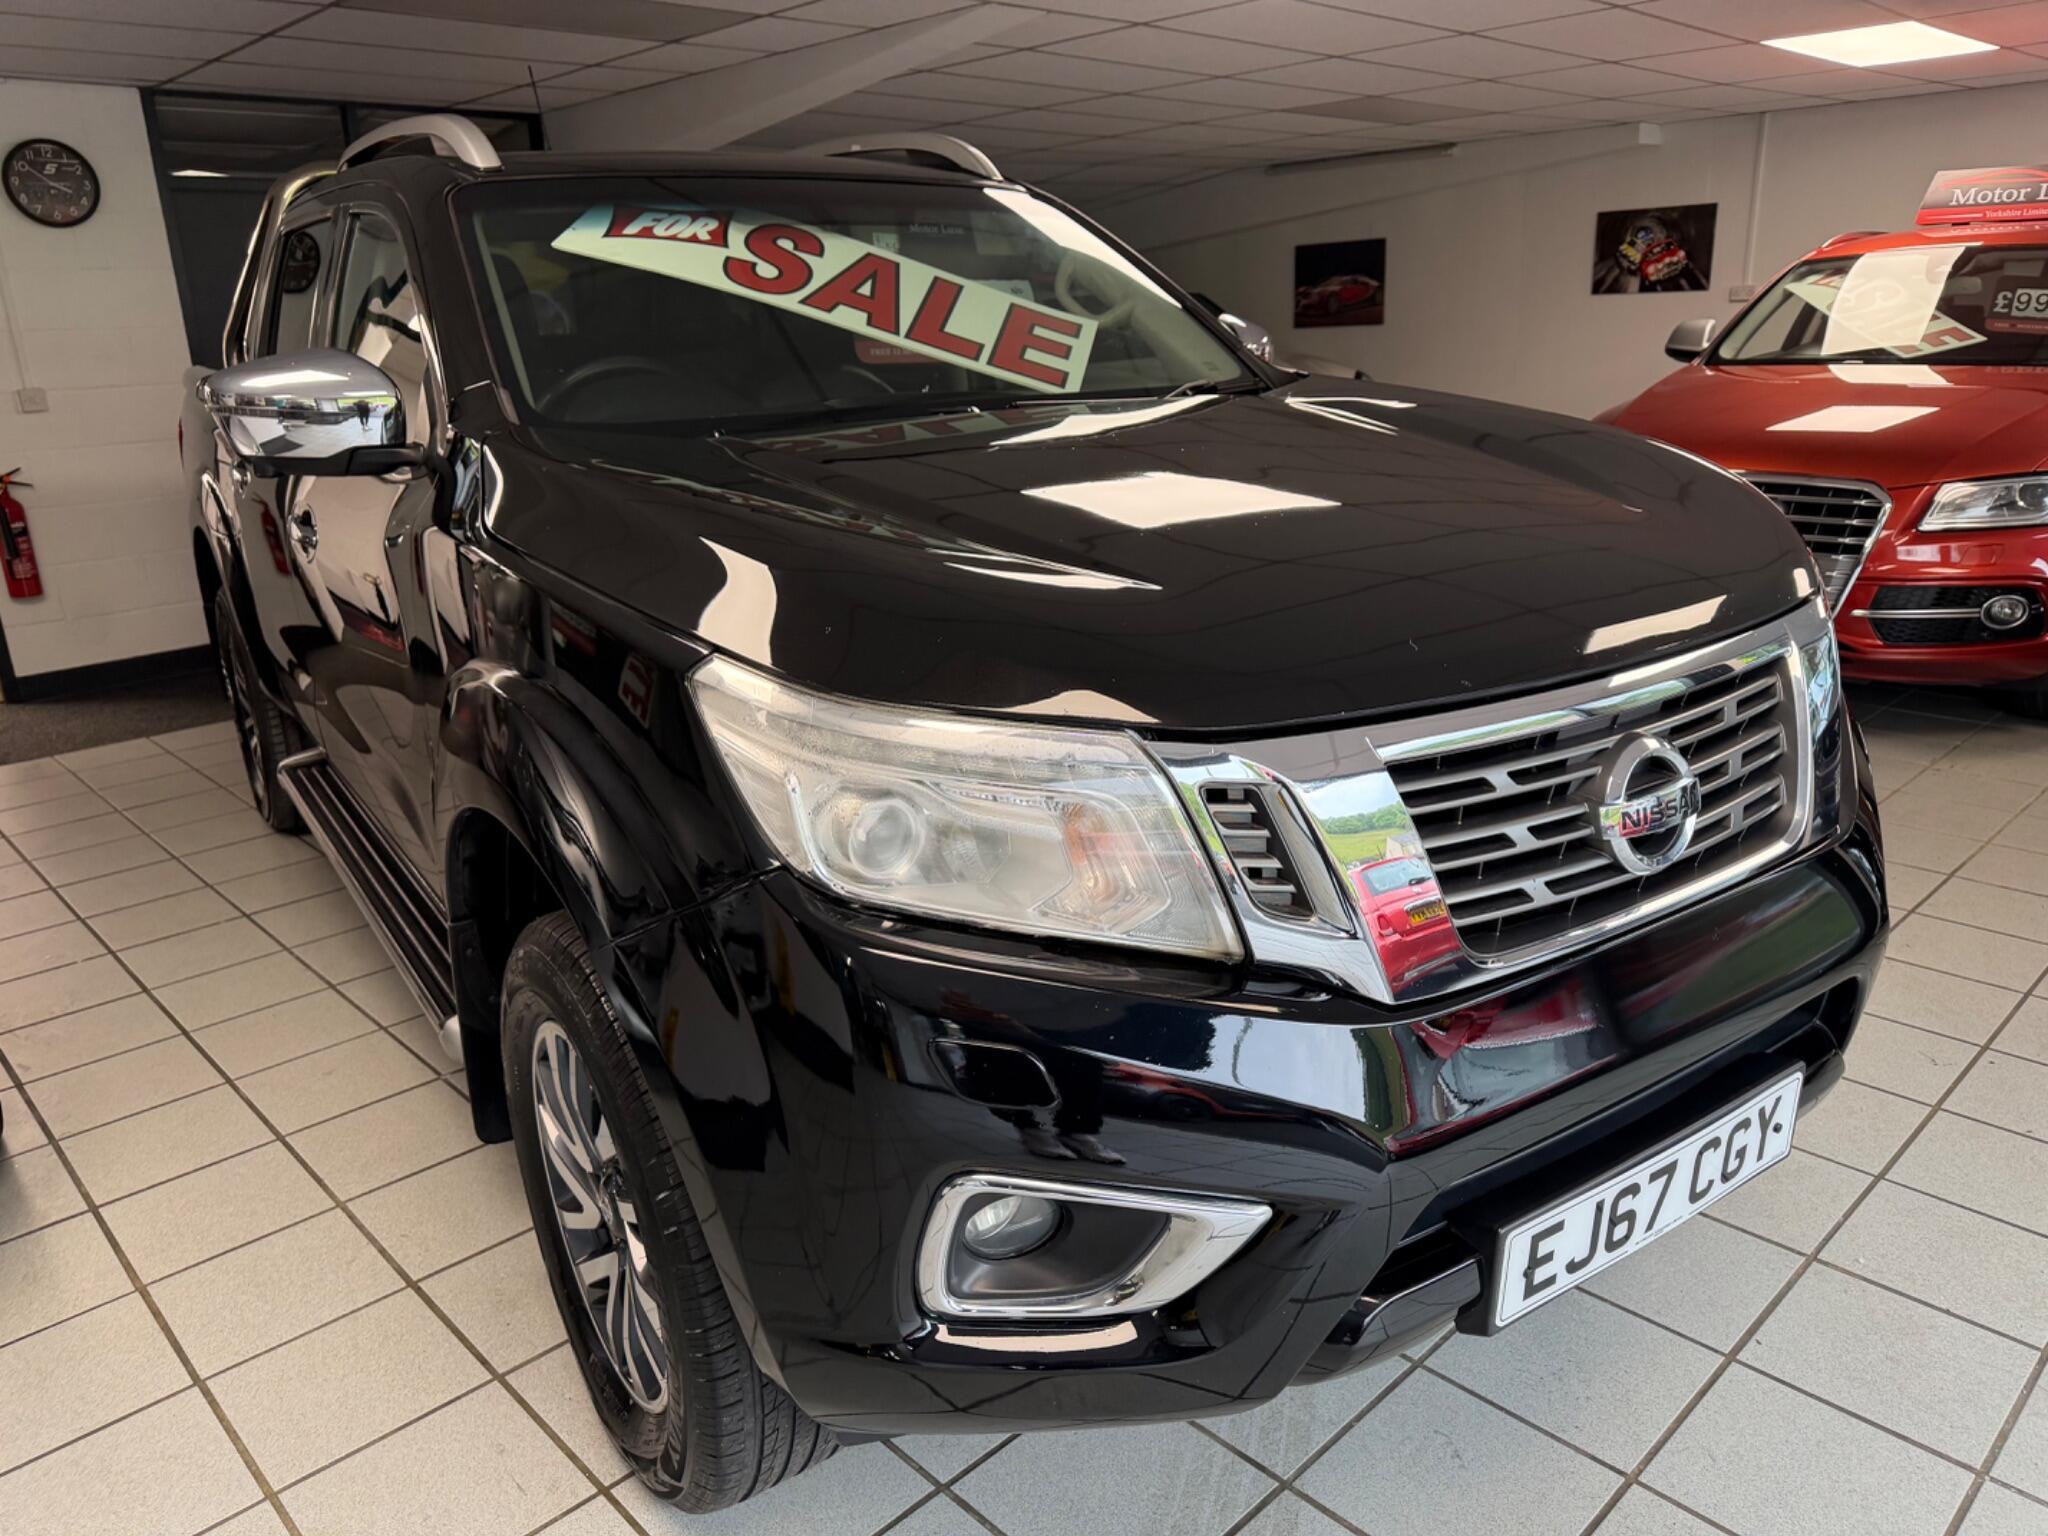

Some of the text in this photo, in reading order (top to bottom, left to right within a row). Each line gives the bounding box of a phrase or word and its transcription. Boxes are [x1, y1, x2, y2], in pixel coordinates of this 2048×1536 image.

[1949, 187, 2031, 205] Motor
[1985, 209, 2022, 218] Yorkshire
[623, 211, 1082, 389] FOR SALE
[1993, 290, 2048, 312] £99
[1523, 1095, 1782, 1302] EJ67 CGY
